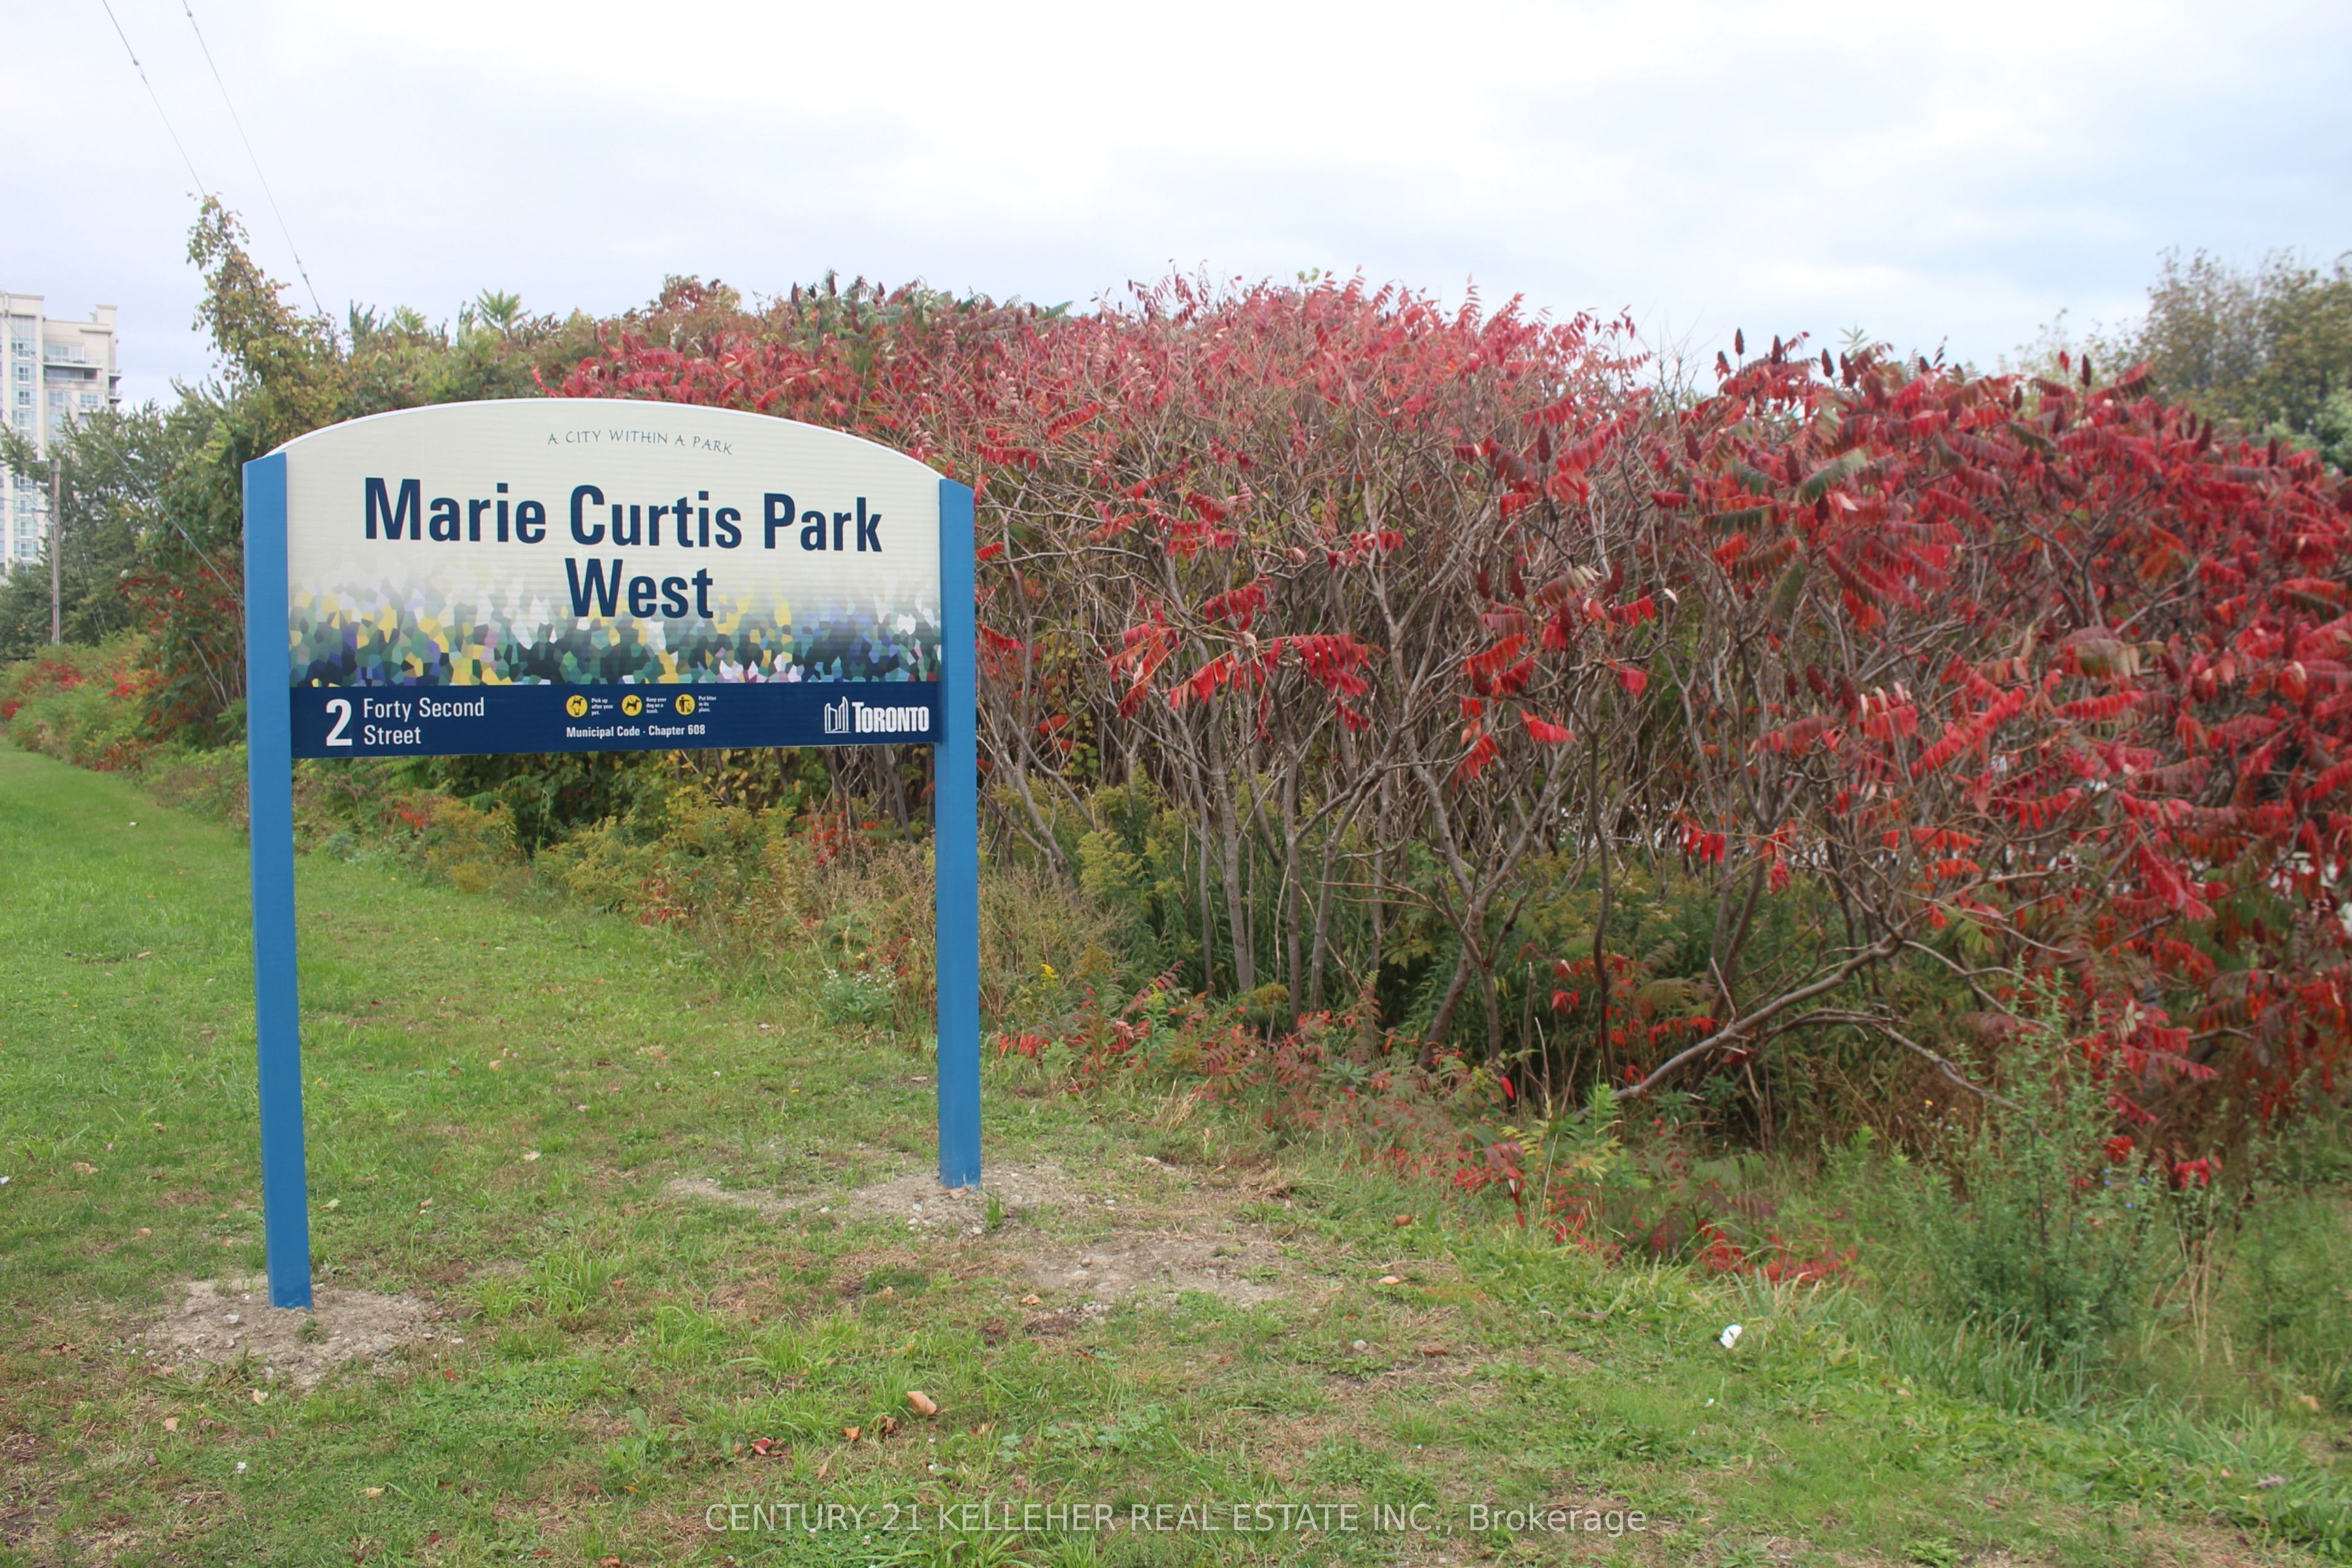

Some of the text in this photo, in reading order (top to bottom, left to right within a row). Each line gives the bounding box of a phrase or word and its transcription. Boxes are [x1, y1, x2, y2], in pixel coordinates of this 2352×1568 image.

[548, 429, 733, 455] A CITY WITHIN A PARK
[366, 478, 881, 552] Marie Curtis Park
[566, 557, 713, 619] West
[326, 699, 352, 746] 2
[364, 697, 484, 722] Forty Second
[851, 701, 929, 733] TORONTO
[364, 725, 421, 745] Street
[566, 725, 614, 739] Municipal
[617, 725, 640, 737] Code
[648, 725, 685, 738] Chapter
[688, 724, 706, 735] 608
